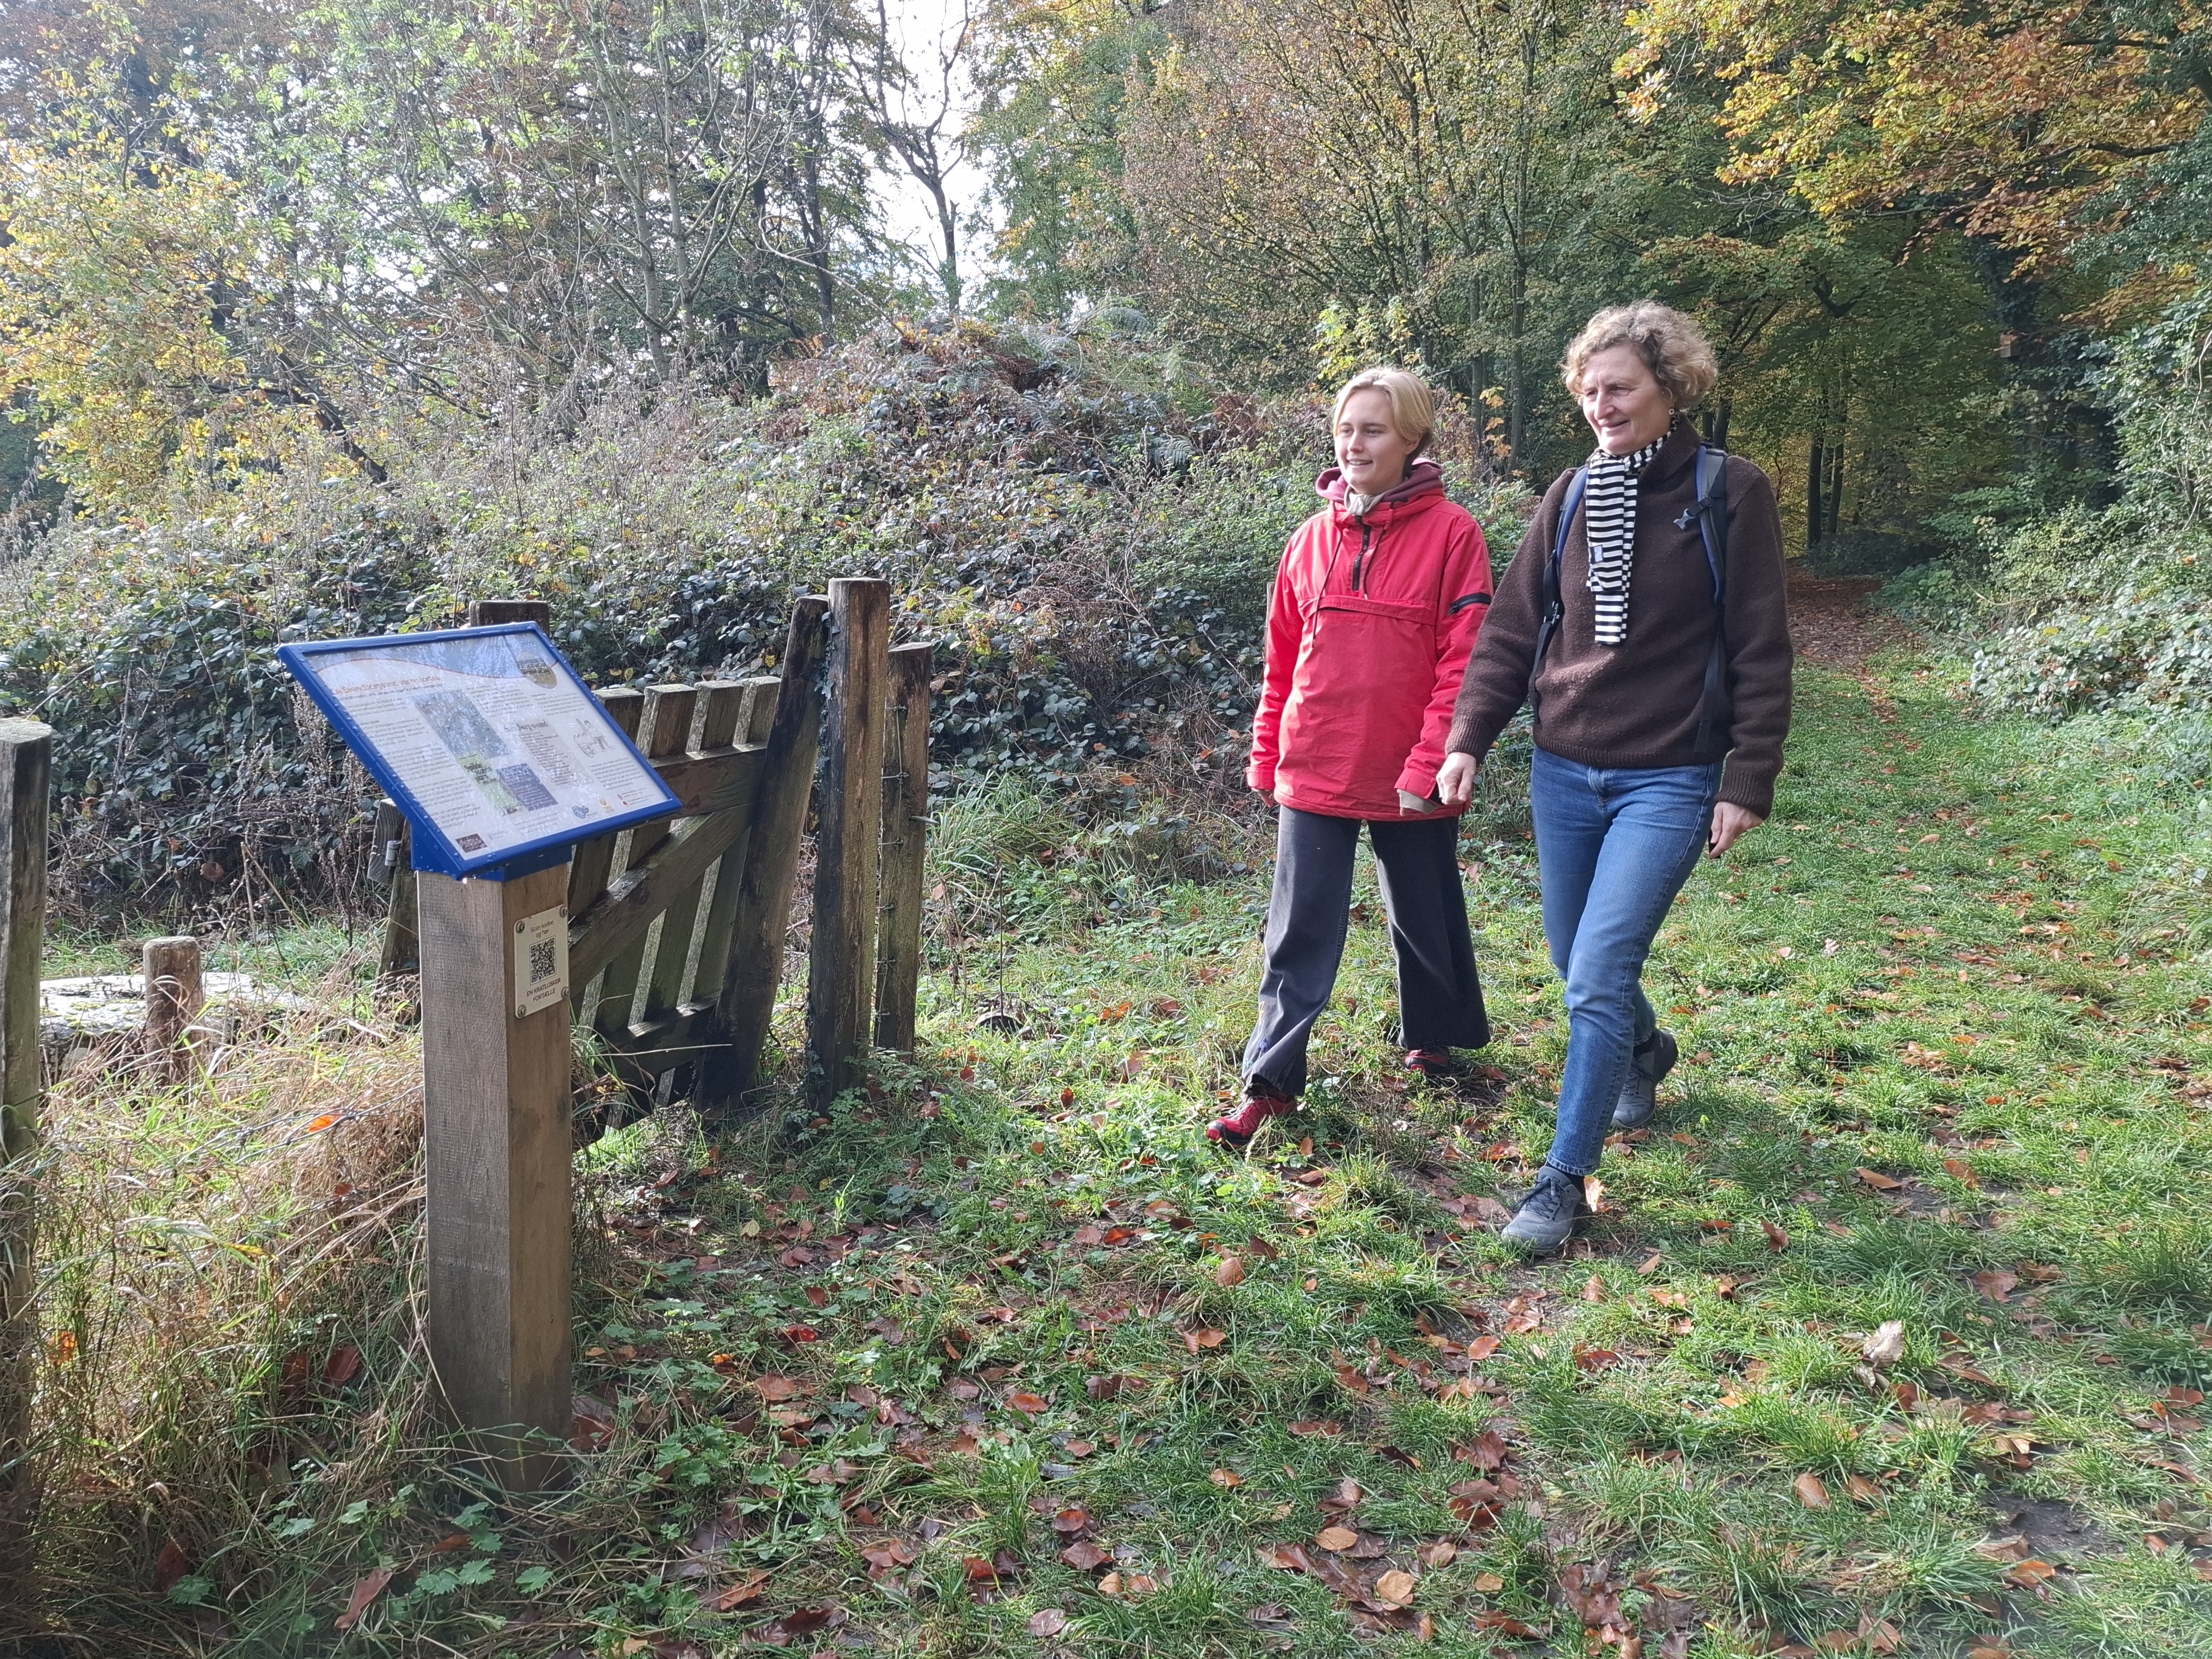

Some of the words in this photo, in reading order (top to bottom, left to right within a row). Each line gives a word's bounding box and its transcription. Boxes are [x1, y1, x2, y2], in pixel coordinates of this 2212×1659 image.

[542, 921, 554, 929] koden
[533, 978, 561, 994] KRATLUSKER
[533, 987, 556, 1002] FORTÆLLE
